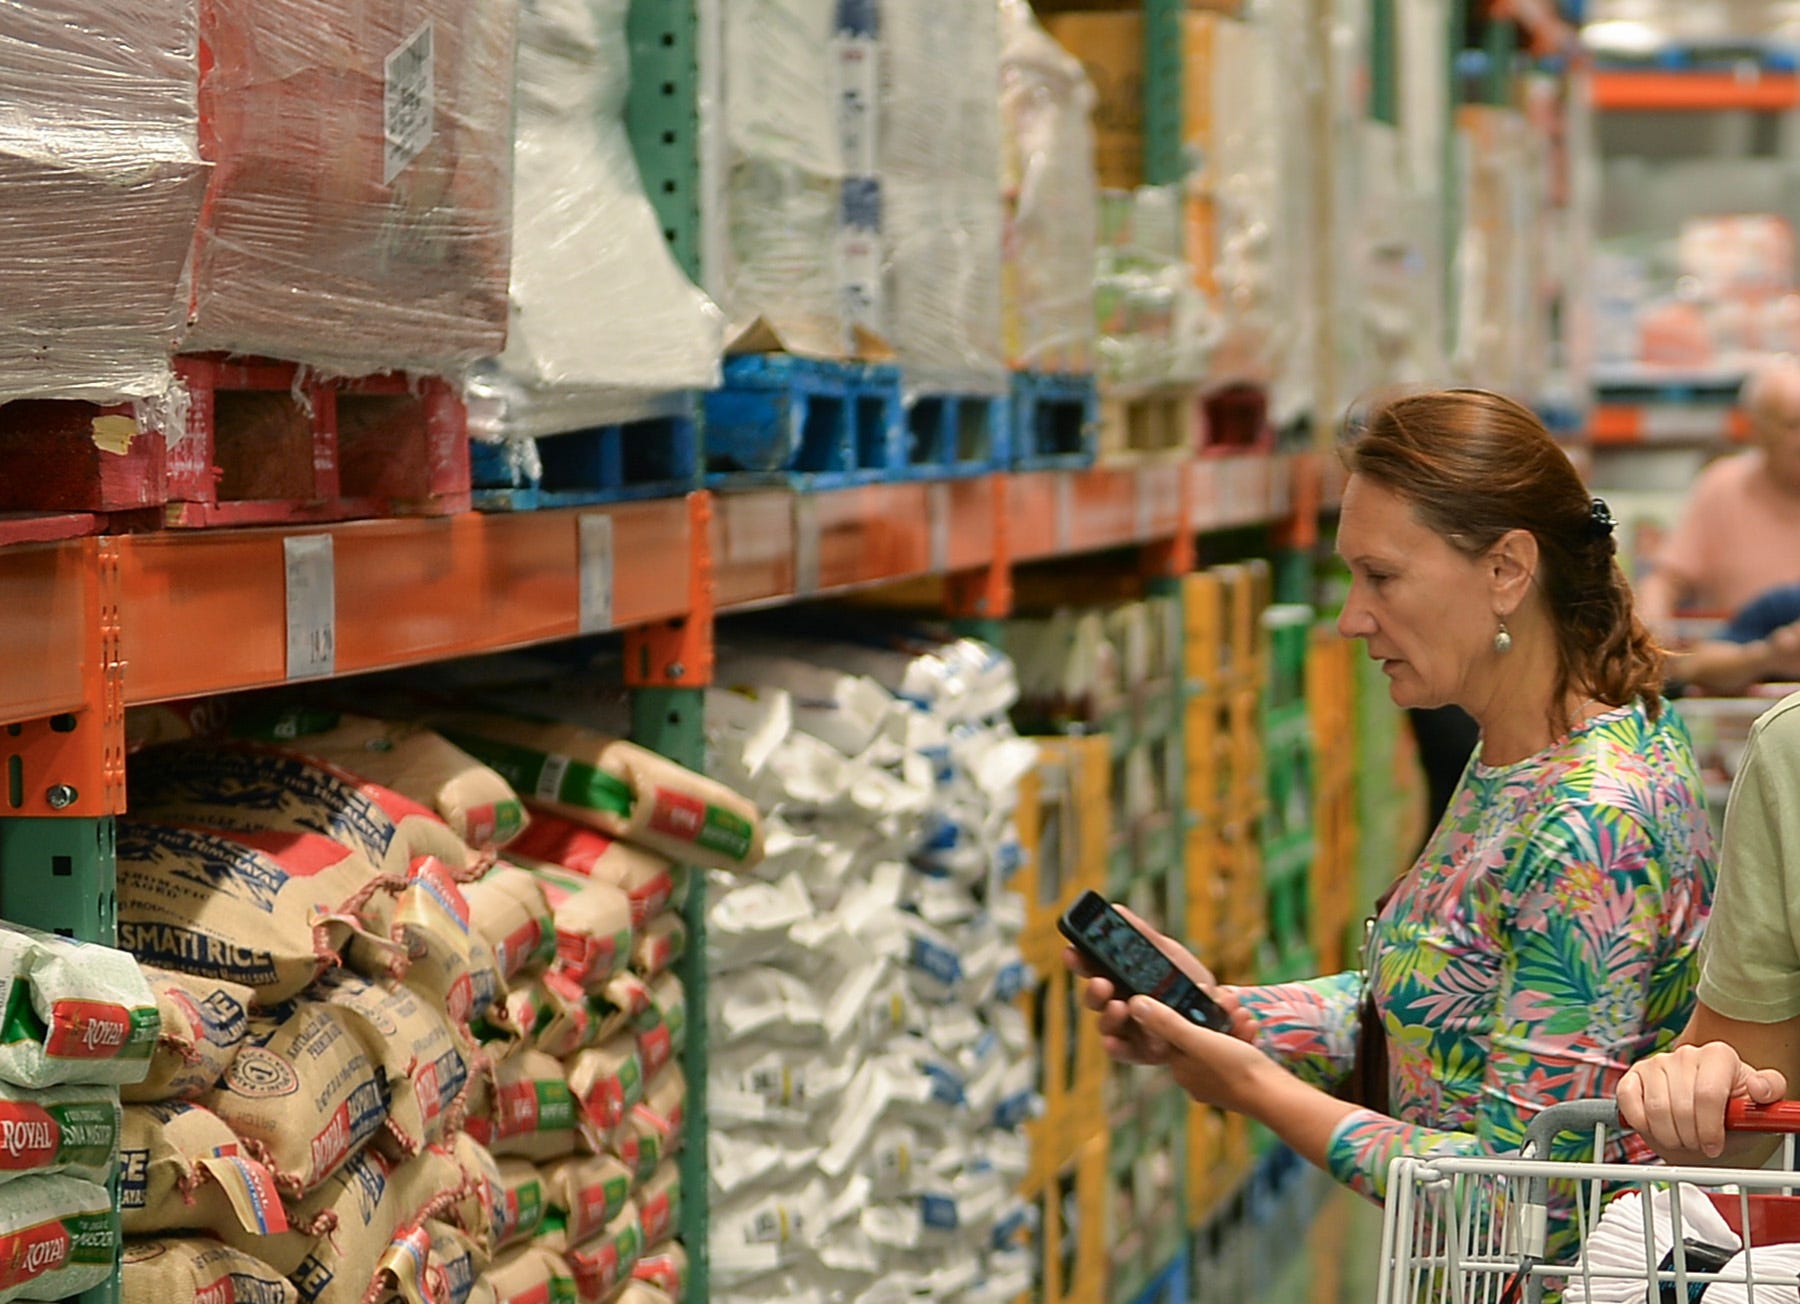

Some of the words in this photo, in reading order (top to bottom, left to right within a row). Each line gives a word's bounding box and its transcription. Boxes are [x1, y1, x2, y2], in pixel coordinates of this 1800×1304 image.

[117, 924, 199, 962] SMATI
[206, 934, 268, 967] RICE
[82, 1018, 125, 1051] ROYAL
[0, 1119, 53, 1158] ROYAL
[22, 1237, 66, 1273] ROYAL
